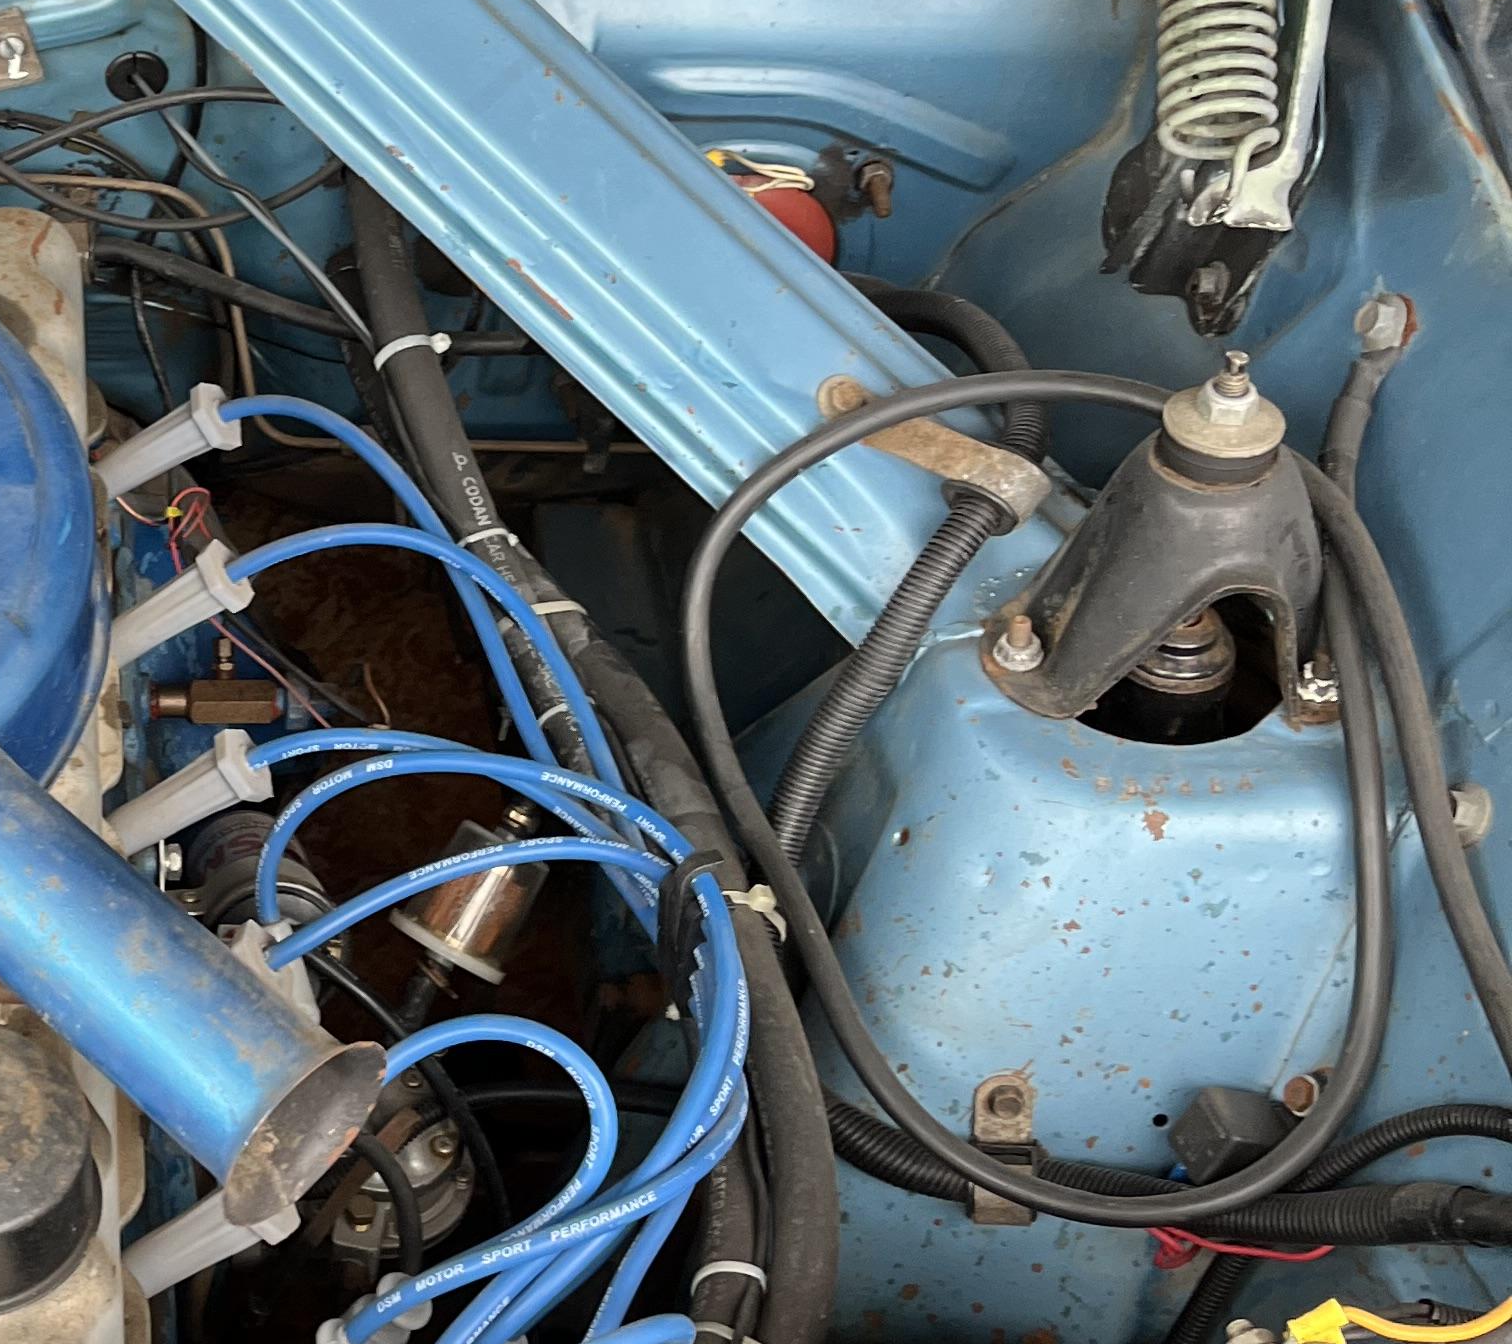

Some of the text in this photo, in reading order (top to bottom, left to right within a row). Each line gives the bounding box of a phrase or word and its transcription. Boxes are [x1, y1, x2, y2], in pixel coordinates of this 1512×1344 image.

[462, 476, 492, 526] CODAN
[311, 769, 353, 796] MOTOR
[365, 758, 394, 773] DSM
[540, 771, 667, 844] PERFORMANCE SPORT
[408, 844, 504, 881] PERFORMANCE
[517, 836, 564, 849] SPORT
[708, 977, 745, 1118] PERFORMANCE SPORT
[525, 1039, 556, 1059] DSM
[565, 1065, 597, 1111] MOTOR
[585, 1123, 602, 1170] SPORT
[376, 1189, 658, 1314] DSM MOTOR SPORT PERFORMANCE
